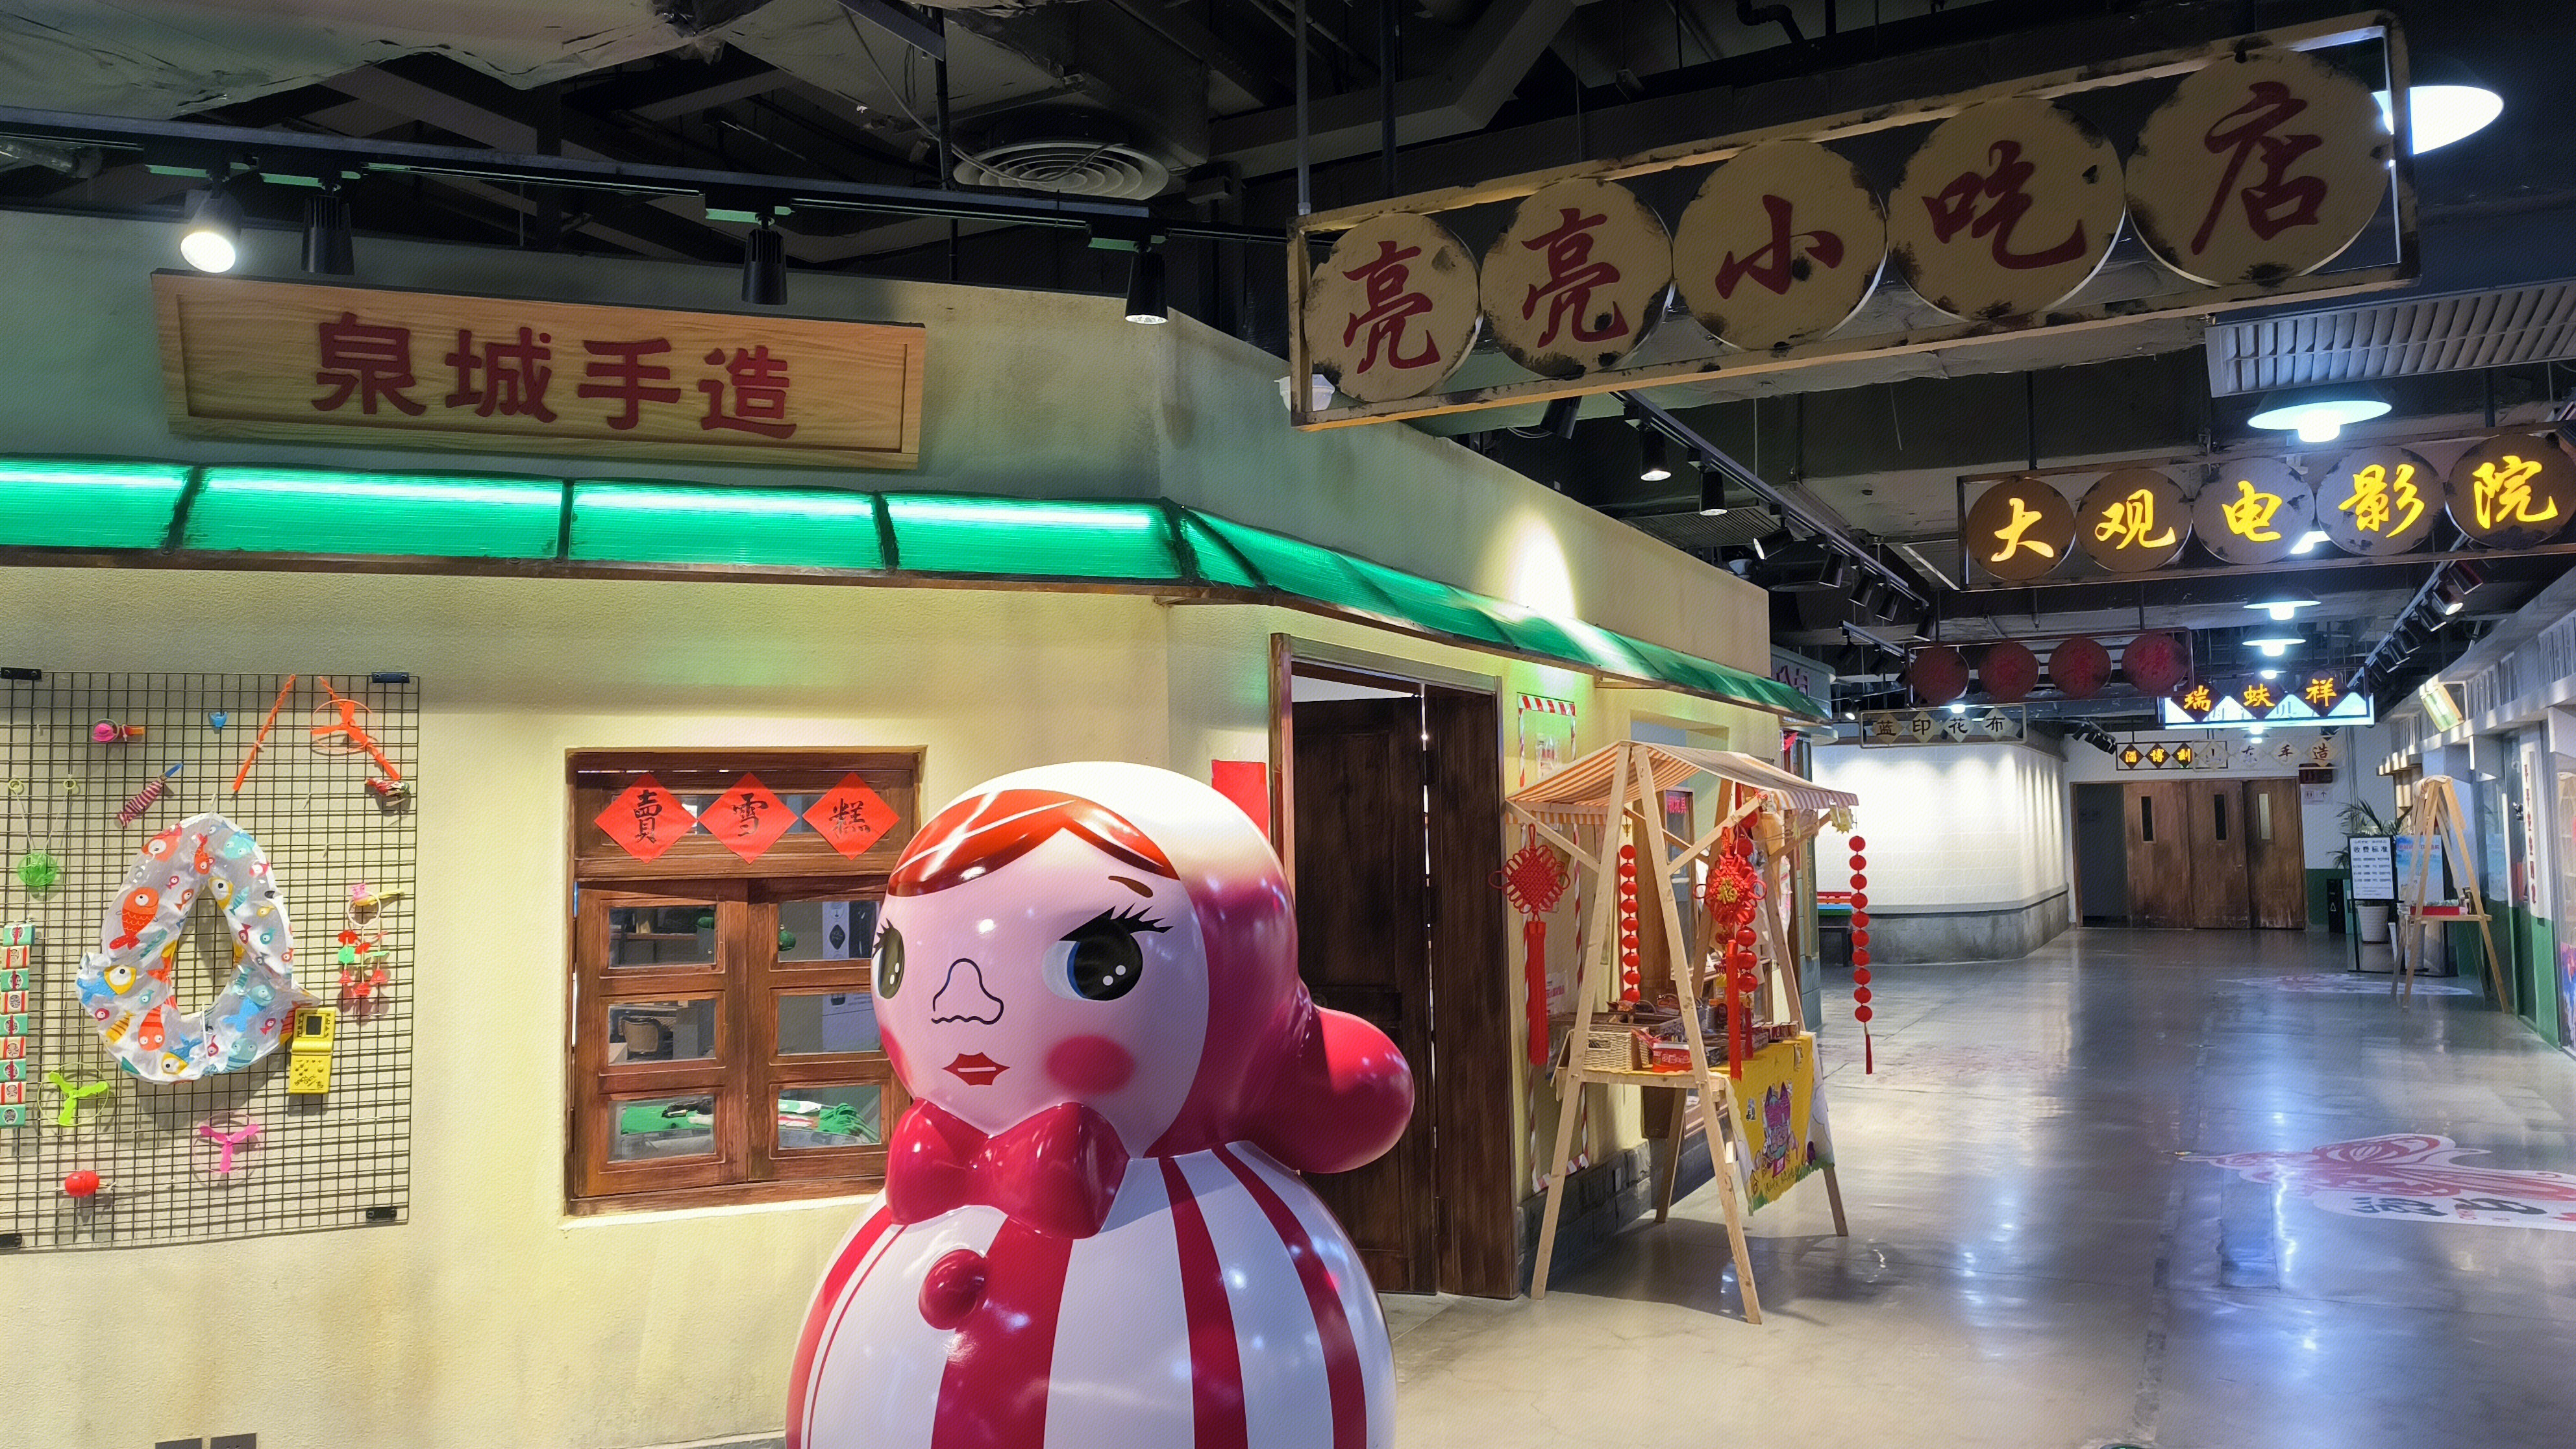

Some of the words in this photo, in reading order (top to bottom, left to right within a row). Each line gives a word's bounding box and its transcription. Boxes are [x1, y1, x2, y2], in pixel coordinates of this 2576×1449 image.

[1343, 82, 2331, 375] 亮亮小吃店
[310, 312, 798, 440] 泉城手造
[1990, 455, 2558, 564] 大观电影院
[1876, 715, 2006, 737] 蓝印花布
[2183, 677, 2337, 712] 瑞蚨祥
[633, 789, 871, 845] 賣雪糕
